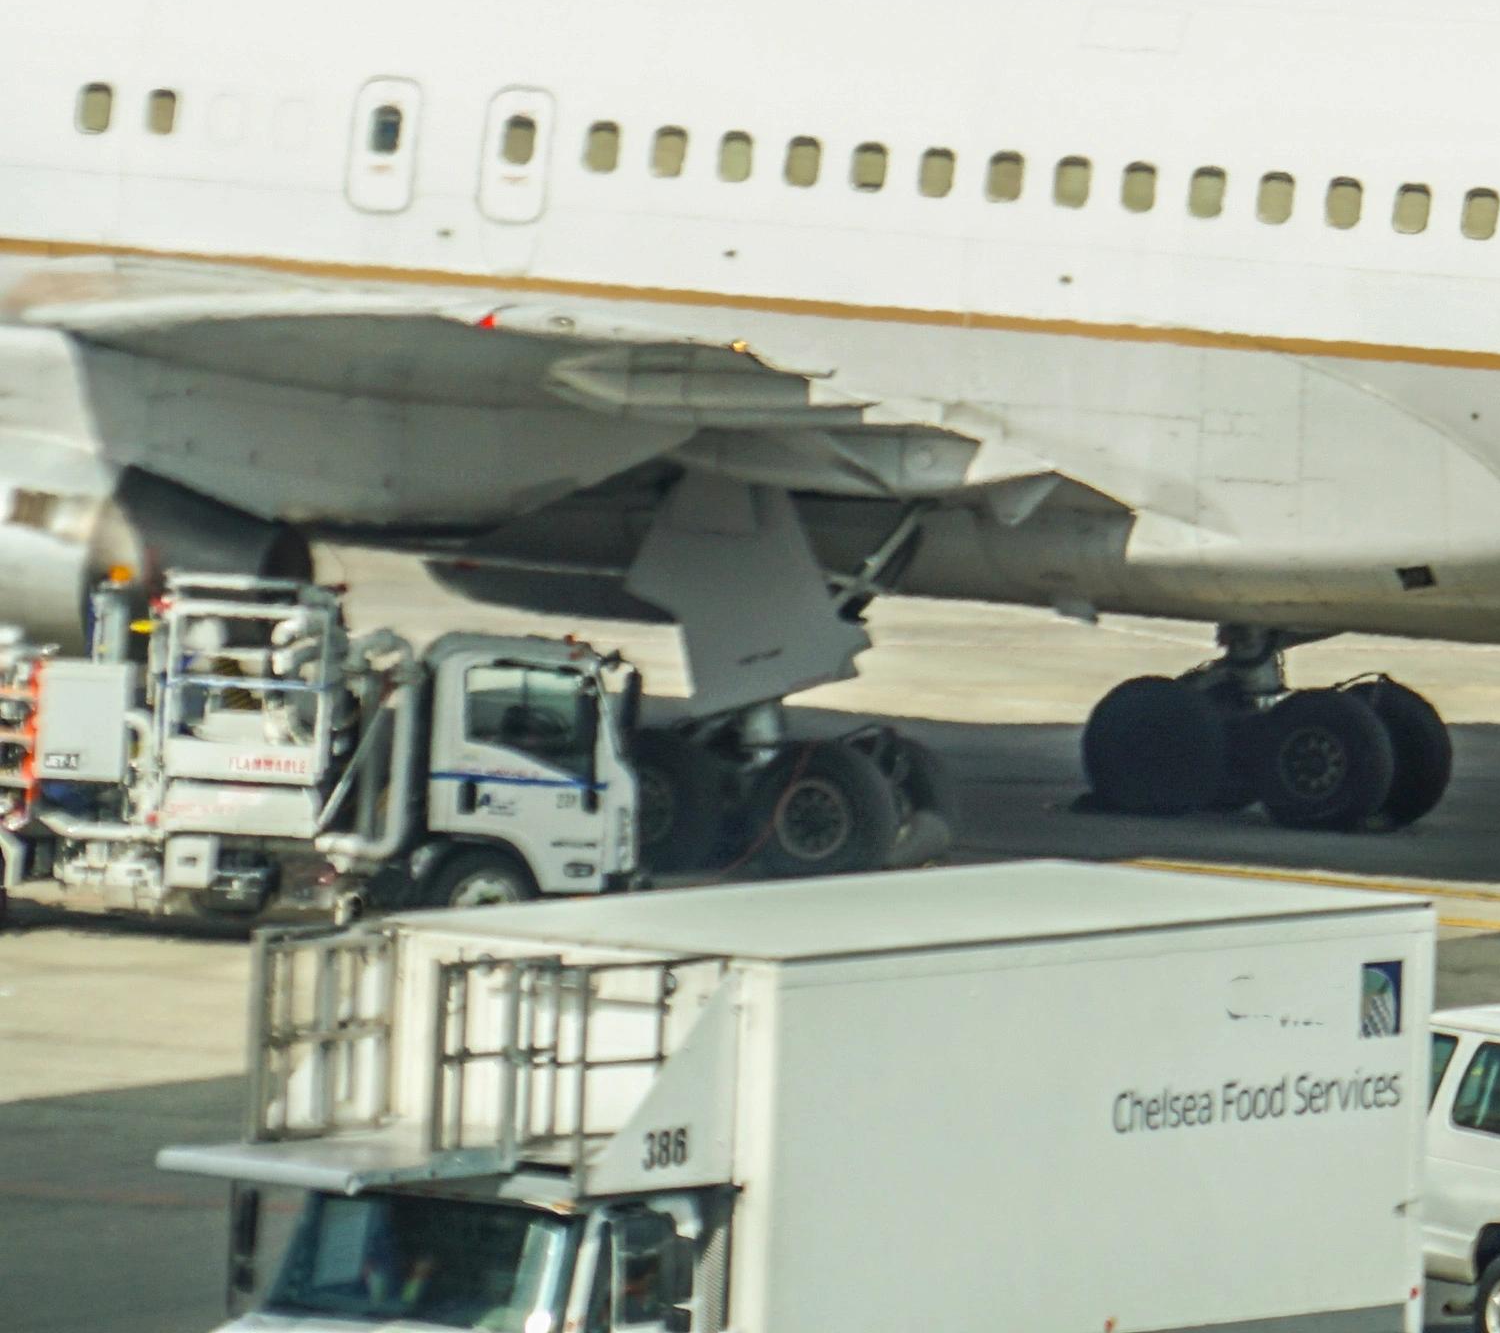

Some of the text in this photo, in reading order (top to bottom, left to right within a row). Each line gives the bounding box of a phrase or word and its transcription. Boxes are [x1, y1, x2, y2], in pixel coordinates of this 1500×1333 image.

[228, 757, 306, 774] FLAMMABLE
[1112, 1069, 1402, 1134] Chelsea Food Services
[642, 1127, 688, 1171] 386
